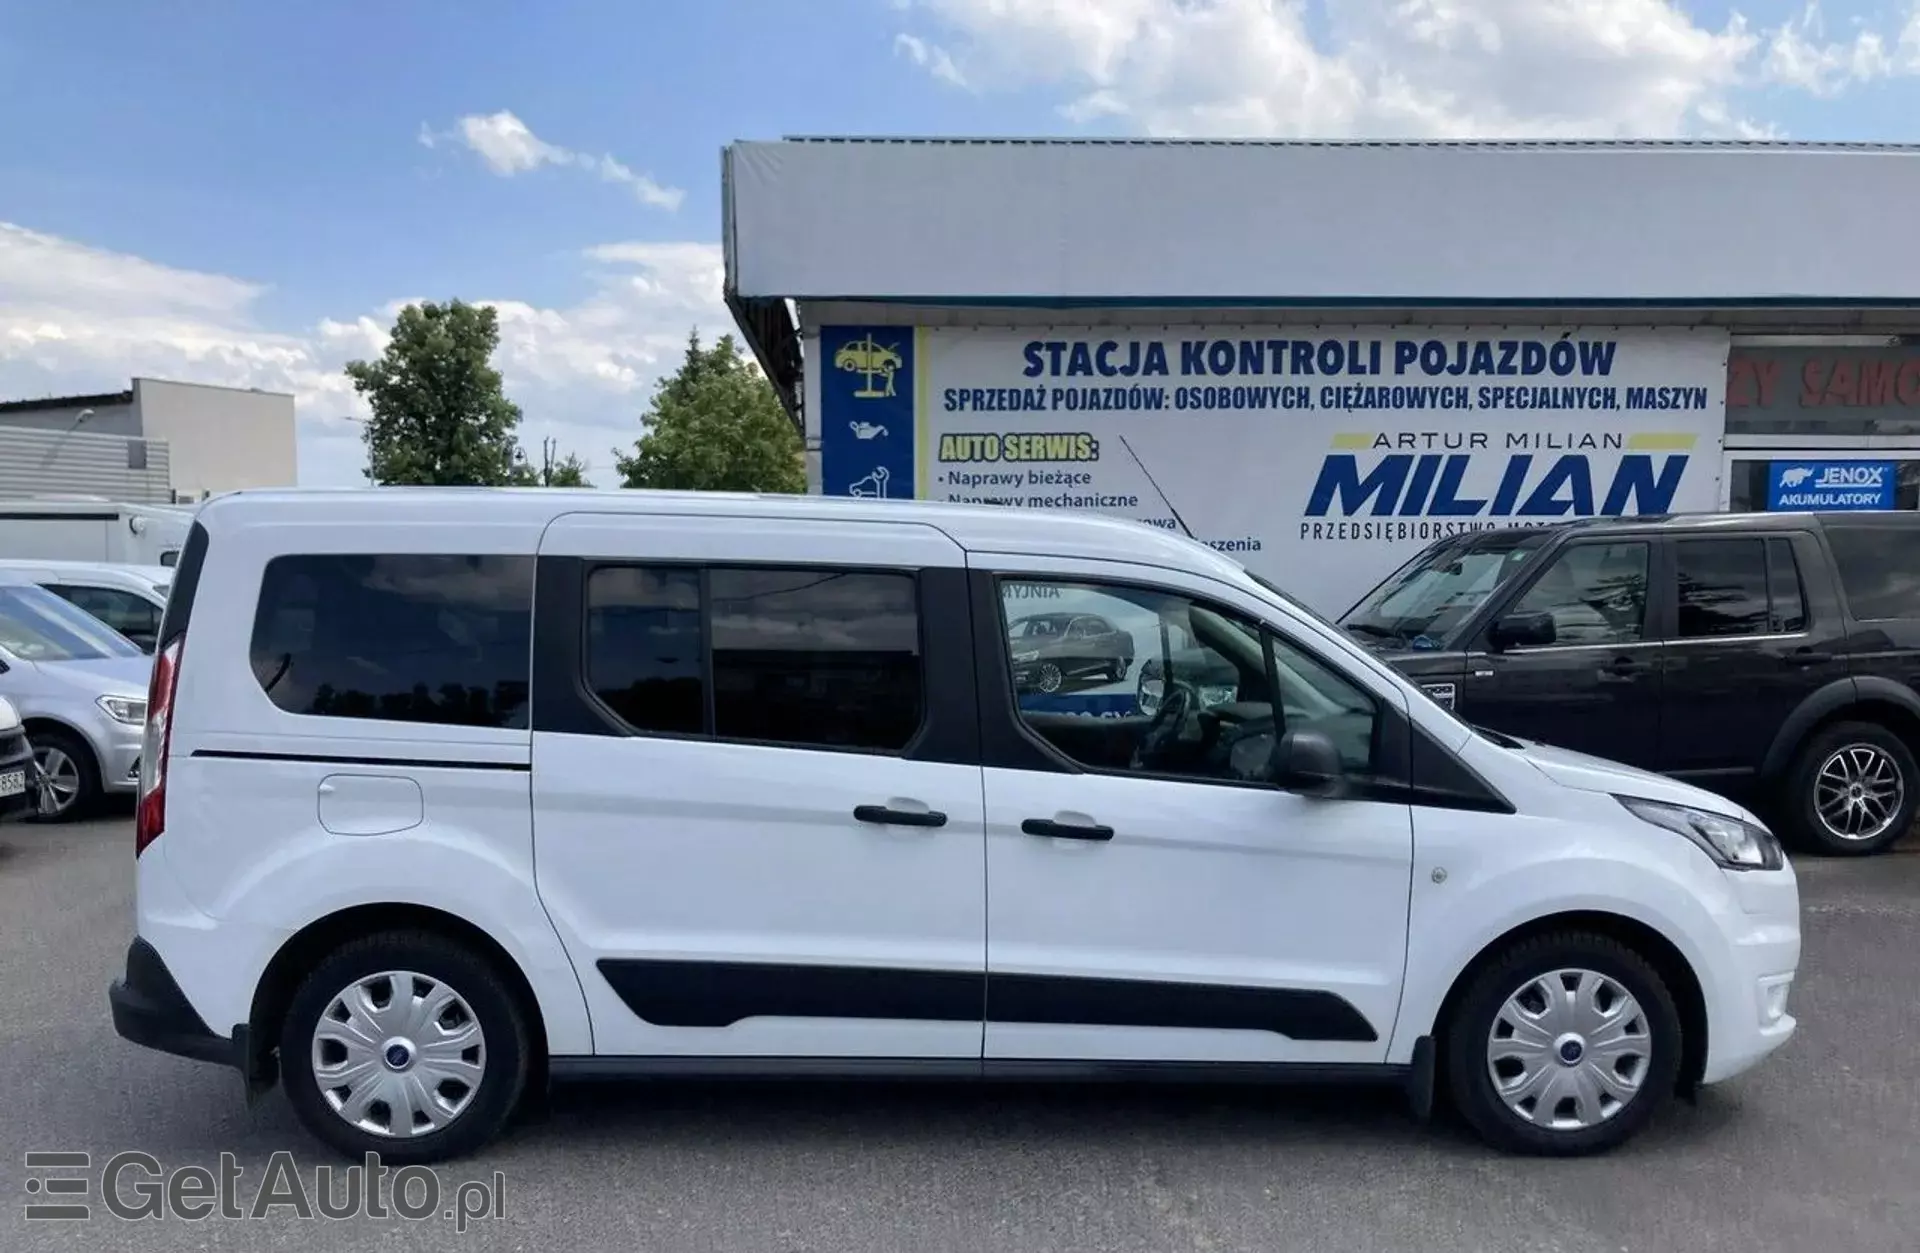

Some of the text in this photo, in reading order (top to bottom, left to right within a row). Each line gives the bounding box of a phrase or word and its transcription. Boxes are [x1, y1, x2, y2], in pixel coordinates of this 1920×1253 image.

[1023, 332, 1616, 377] STACJA KONTROLI POJAZDÓW
[944, 382, 1708, 413] SPRZEDAŻ POJAZDÓW: OSOBOWYCH, CIĘŻAROWYCH, SPECJALNYCH, MASZYN
[939, 432, 1099, 462] AUTO SERWIS:
[1372, 432, 1623, 449] ARTUR MILIAN
[948, 470, 1092, 488] Naprawy bieżące
[1815, 467, 1883, 484] JENOX
[1304, 454, 1690, 516] MILIAN
[1028, 492, 1138, 507] mechaniczne
[1779, 493, 1881, 506] AKUMULATORY
